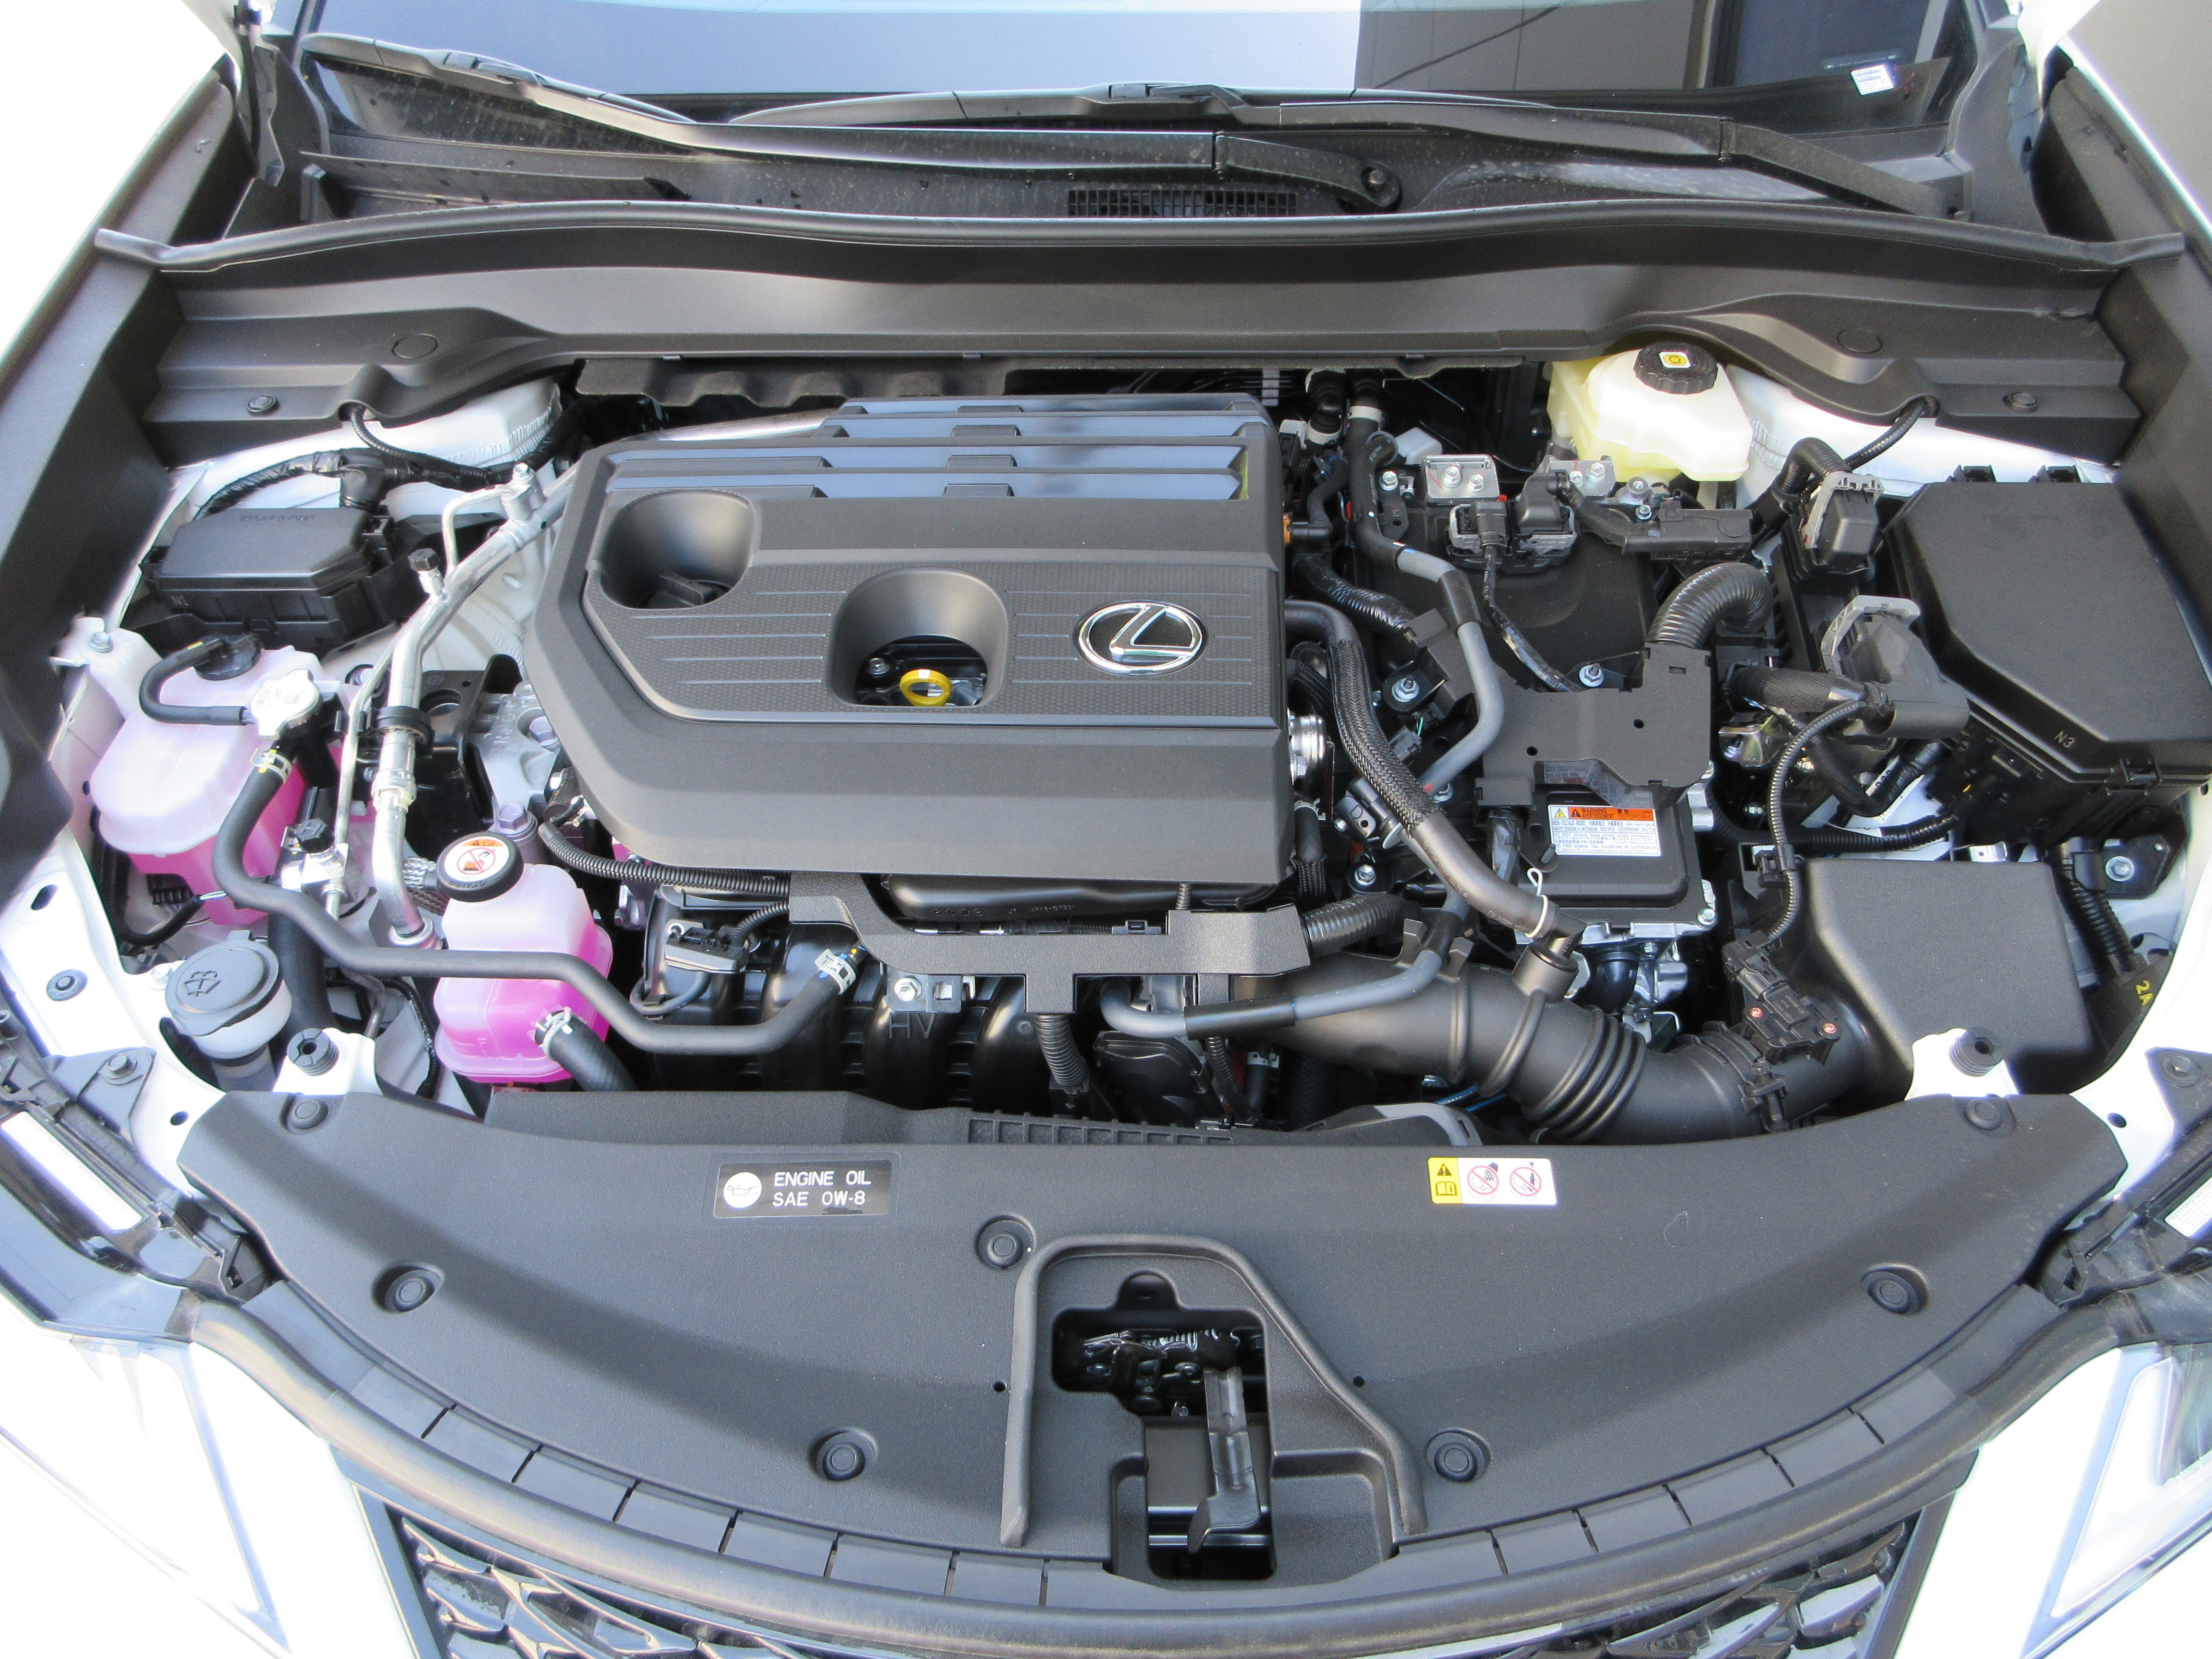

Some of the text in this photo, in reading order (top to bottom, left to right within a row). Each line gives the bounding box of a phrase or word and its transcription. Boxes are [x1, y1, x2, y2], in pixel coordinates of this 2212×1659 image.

[2054, 731, 2075, 748] N3
[2135, 980, 2154, 1006] 2A
[889, 1013, 936, 1039] HV
[774, 1170, 872, 1187] ENGINE OIL
[772, 1190, 866, 1207] SAE 0W-8
